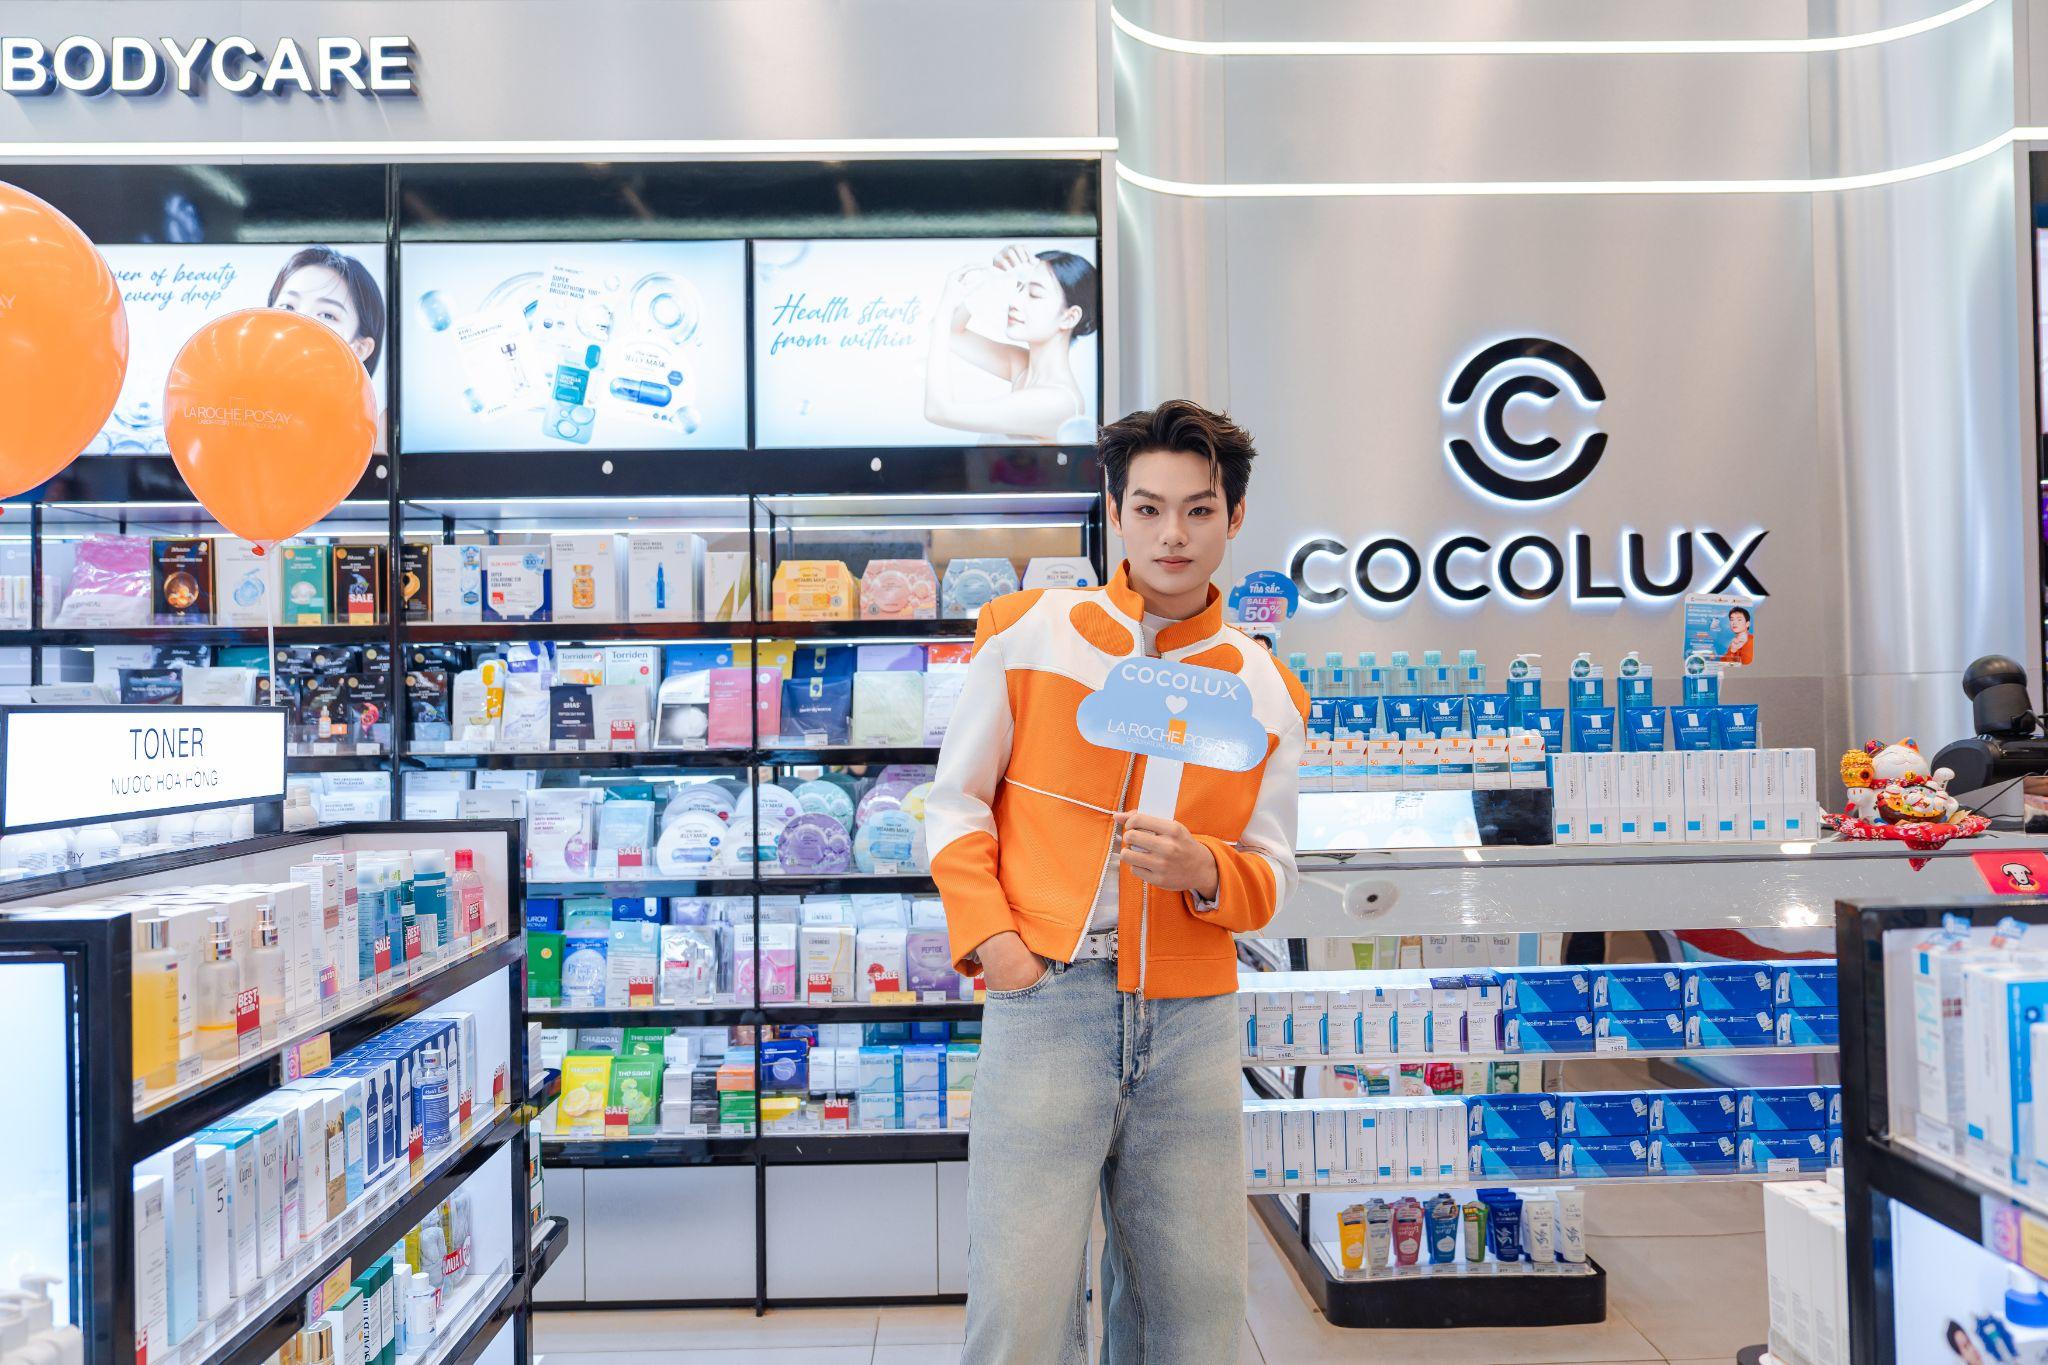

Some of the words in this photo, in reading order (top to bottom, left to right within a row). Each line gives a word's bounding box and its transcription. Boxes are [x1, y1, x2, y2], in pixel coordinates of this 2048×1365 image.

[1, 36, 414, 97] BODYCARE
[149, 267, 168, 290] of
[172, 262, 238, 291] beauty
[124, 289, 175, 311] every
[180, 287, 223, 310] drop
[771, 292, 851, 326] Health
[857, 295, 922, 326] starts
[770, 330, 832, 356] from
[839, 325, 917, 351] within
[198, 407, 243, 422] ROCHE
[244, 408, 292, 425] POSAY
[1290, 530, 1770, 604] COCOLUX
[348, 593, 375, 603] SALE
[1244, 605, 1282, 622] 50%
[561, 652, 592, 660] Torriden
[611, 651, 648, 659] Torriden
[1121, 663, 1241, 701] COCOLUX
[613, 720, 633, 728] BEST
[1107, 719, 1127, 736] LA
[1128, 722, 1182, 744] ROCHE
[129, 727, 204, 760] TONER
[618, 847, 642, 856] SALE
[407, 924, 420, 940] BEST
[374, 936, 391, 955] SALE
[630, 976, 654, 985] SALE
[238, 988, 259, 1008] BEST
[581, 1035, 620, 1043] CHARCOAL
[605, 1106, 629, 1115] SALE
[824, 1099, 849, 1108] SALE
[408, 1122, 424, 1144] SALE
